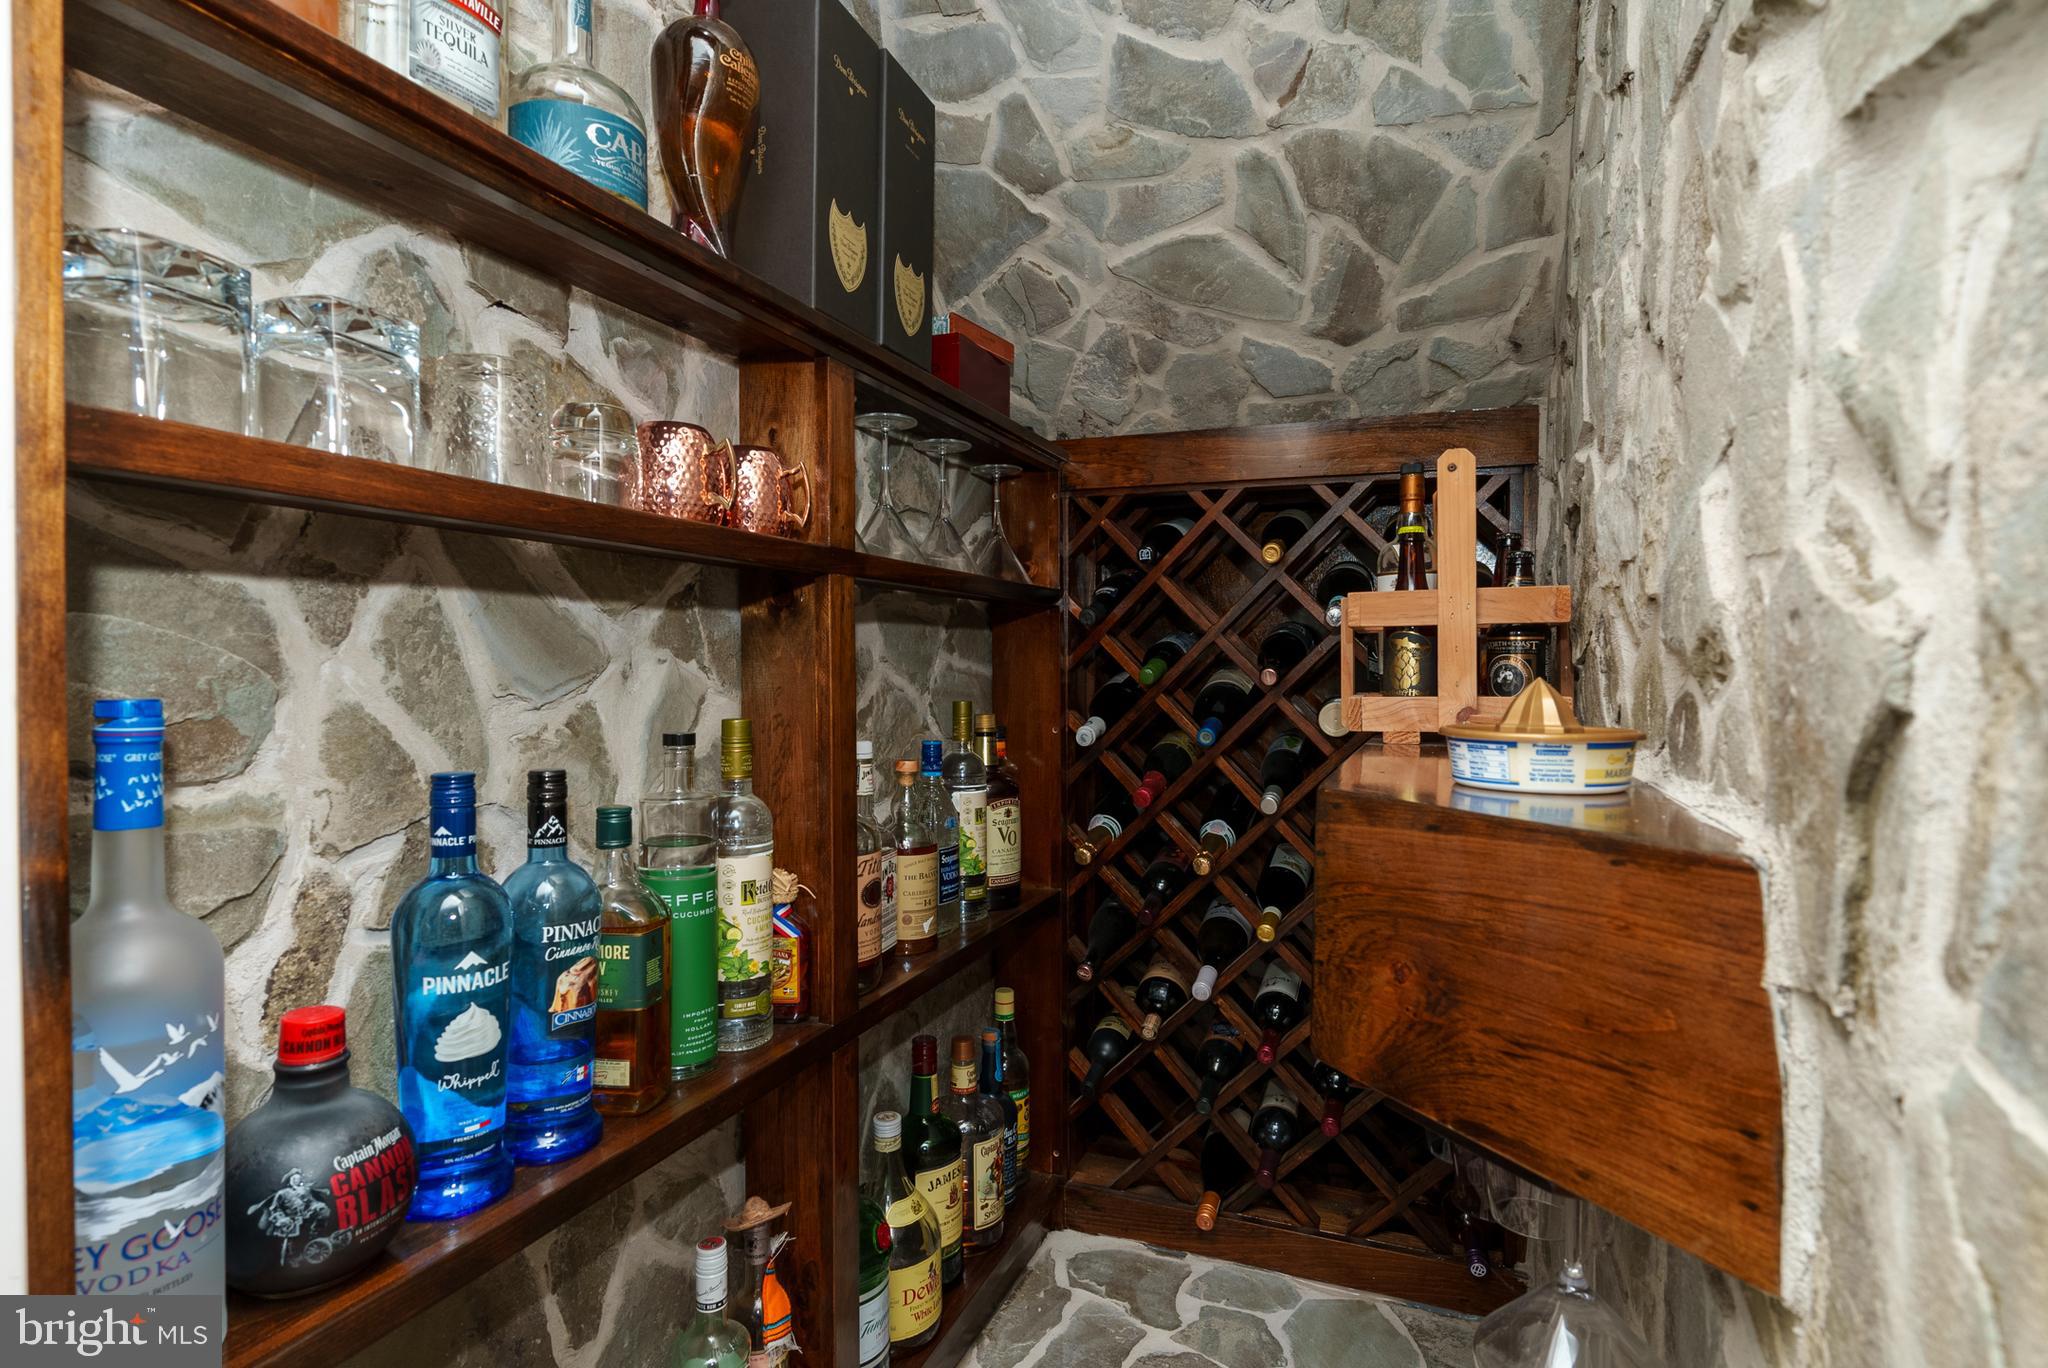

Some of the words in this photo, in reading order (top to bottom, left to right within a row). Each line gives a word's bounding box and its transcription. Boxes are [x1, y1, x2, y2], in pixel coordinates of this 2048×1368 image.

[423, 18, 489, 68] TEQUILA
[439, 14, 477, 44] SILVER
[585, 122, 646, 168] CAB
[1511, 640, 1538, 650] COAST
[534, 837, 566, 846] PINNACLE
[661, 890, 719, 906] EFFE
[743, 882, 768, 903] Ketel
[422, 961, 510, 997] PINNACLE
[284, 1034, 330, 1055] CANNON
[437, 1059, 500, 1093] Whipped
[333, 1144, 375, 1172] Captain
[121, 1201, 223, 1262] GOOSE
[76, 1251, 192, 1296] VODKA
